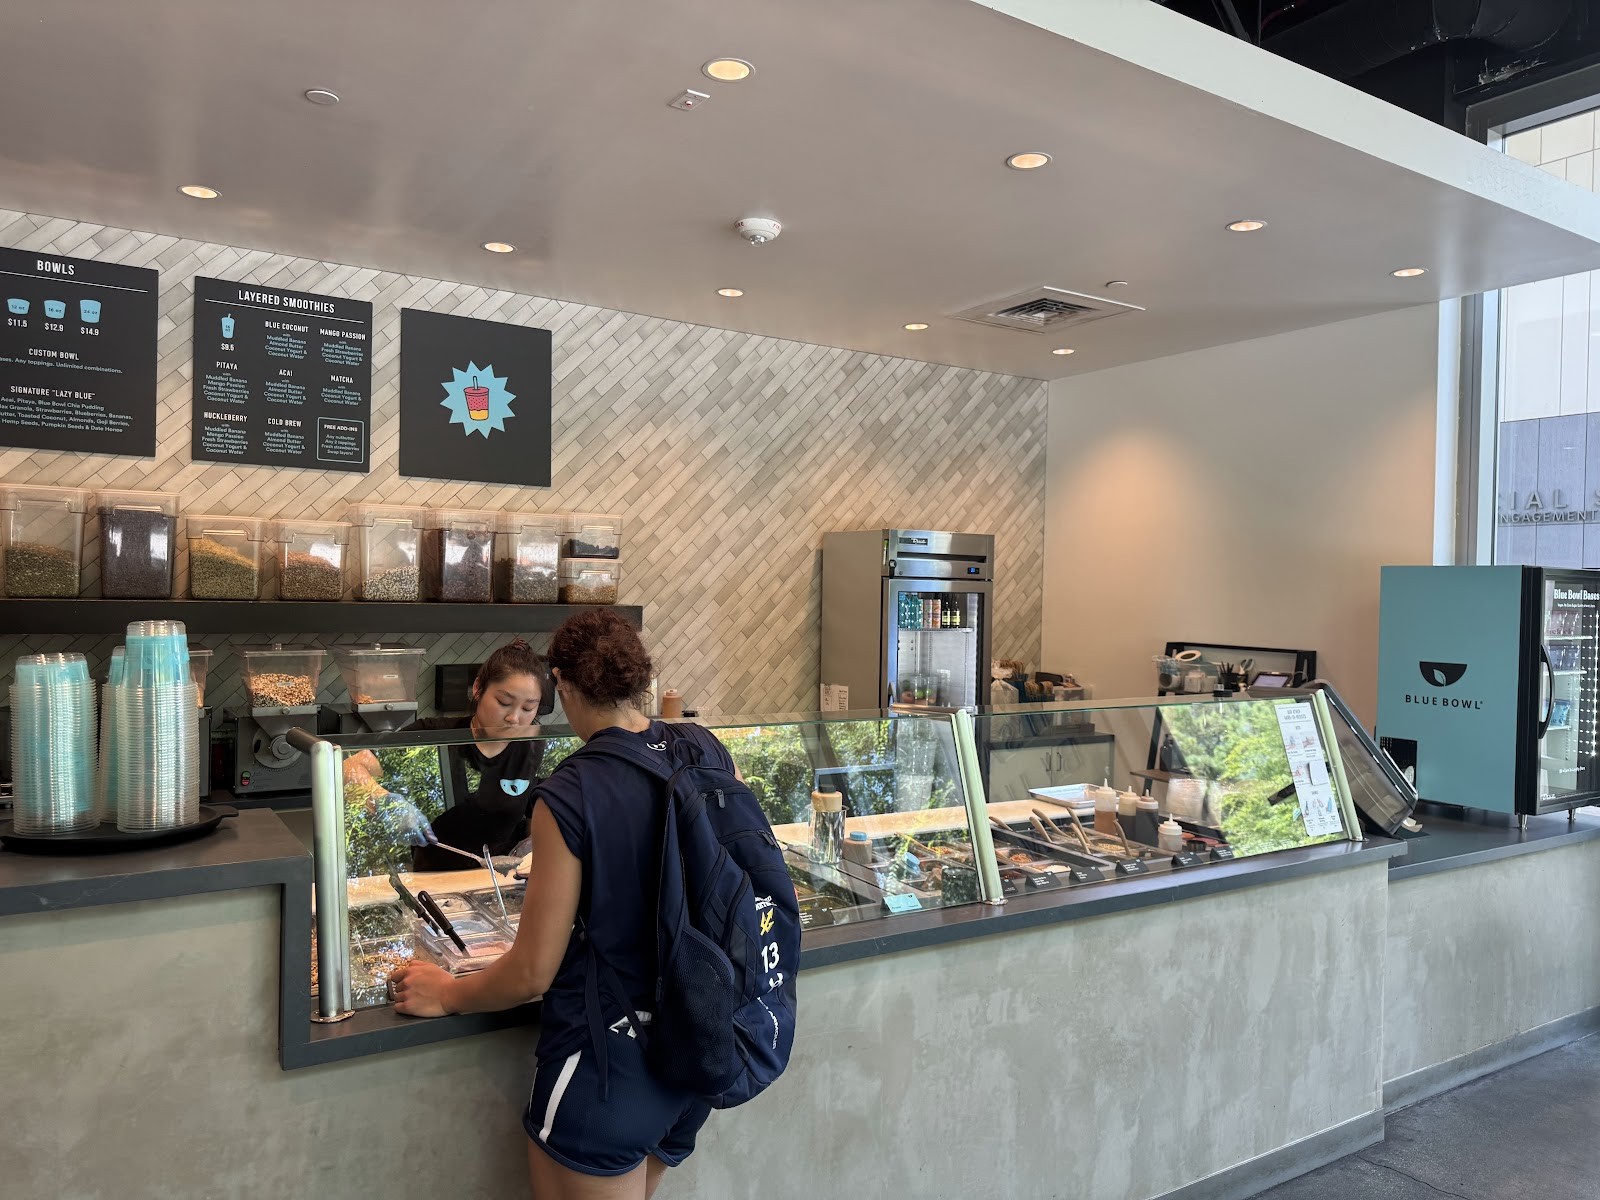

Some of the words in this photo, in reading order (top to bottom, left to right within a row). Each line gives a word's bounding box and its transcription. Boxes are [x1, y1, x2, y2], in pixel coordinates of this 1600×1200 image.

[37, 260, 75, 275] BOWLS
[238, 290, 280, 306] LAYERED
[282, 296, 335, 314] SMOOTHIES
[8, 318, 28, 328] $11.5
[44, 322, 64, 332] $12.9
[264, 320, 280, 329] BLUE
[282, 323, 309, 333] COCONUT
[80, 326, 99, 336] $14.9
[320, 328, 340, 337] MANGO
[341, 331, 366, 340] PASSION
[28, 348, 57, 358] CUSTOM
[60, 351, 79, 360] BOWL
[56, 362, 83, 370] Unlimited
[84, 365, 122, 374] combinations.
[216, 361, 238, 370] PITAYA
[278, 369, 293, 377] ACAI
[330, 374, 354, 384] MATCHA
[11, 385, 50, 396] SIGNATURE
[203, 411, 248, 422] HUCKLEBERRY
[267, 417, 284, 426] COLD
[284, 419, 302, 428] BREW
[1499, 489, 1568, 511] IAL
[1500, 510, 1598, 524] NGAGEMENT
[1554, 588, 1568, 600] Blue
[1568, 588, 1582, 600] Bowl
[1405, 694, 1438, 706] BLUE
[761, 941, 780, 973] 13
